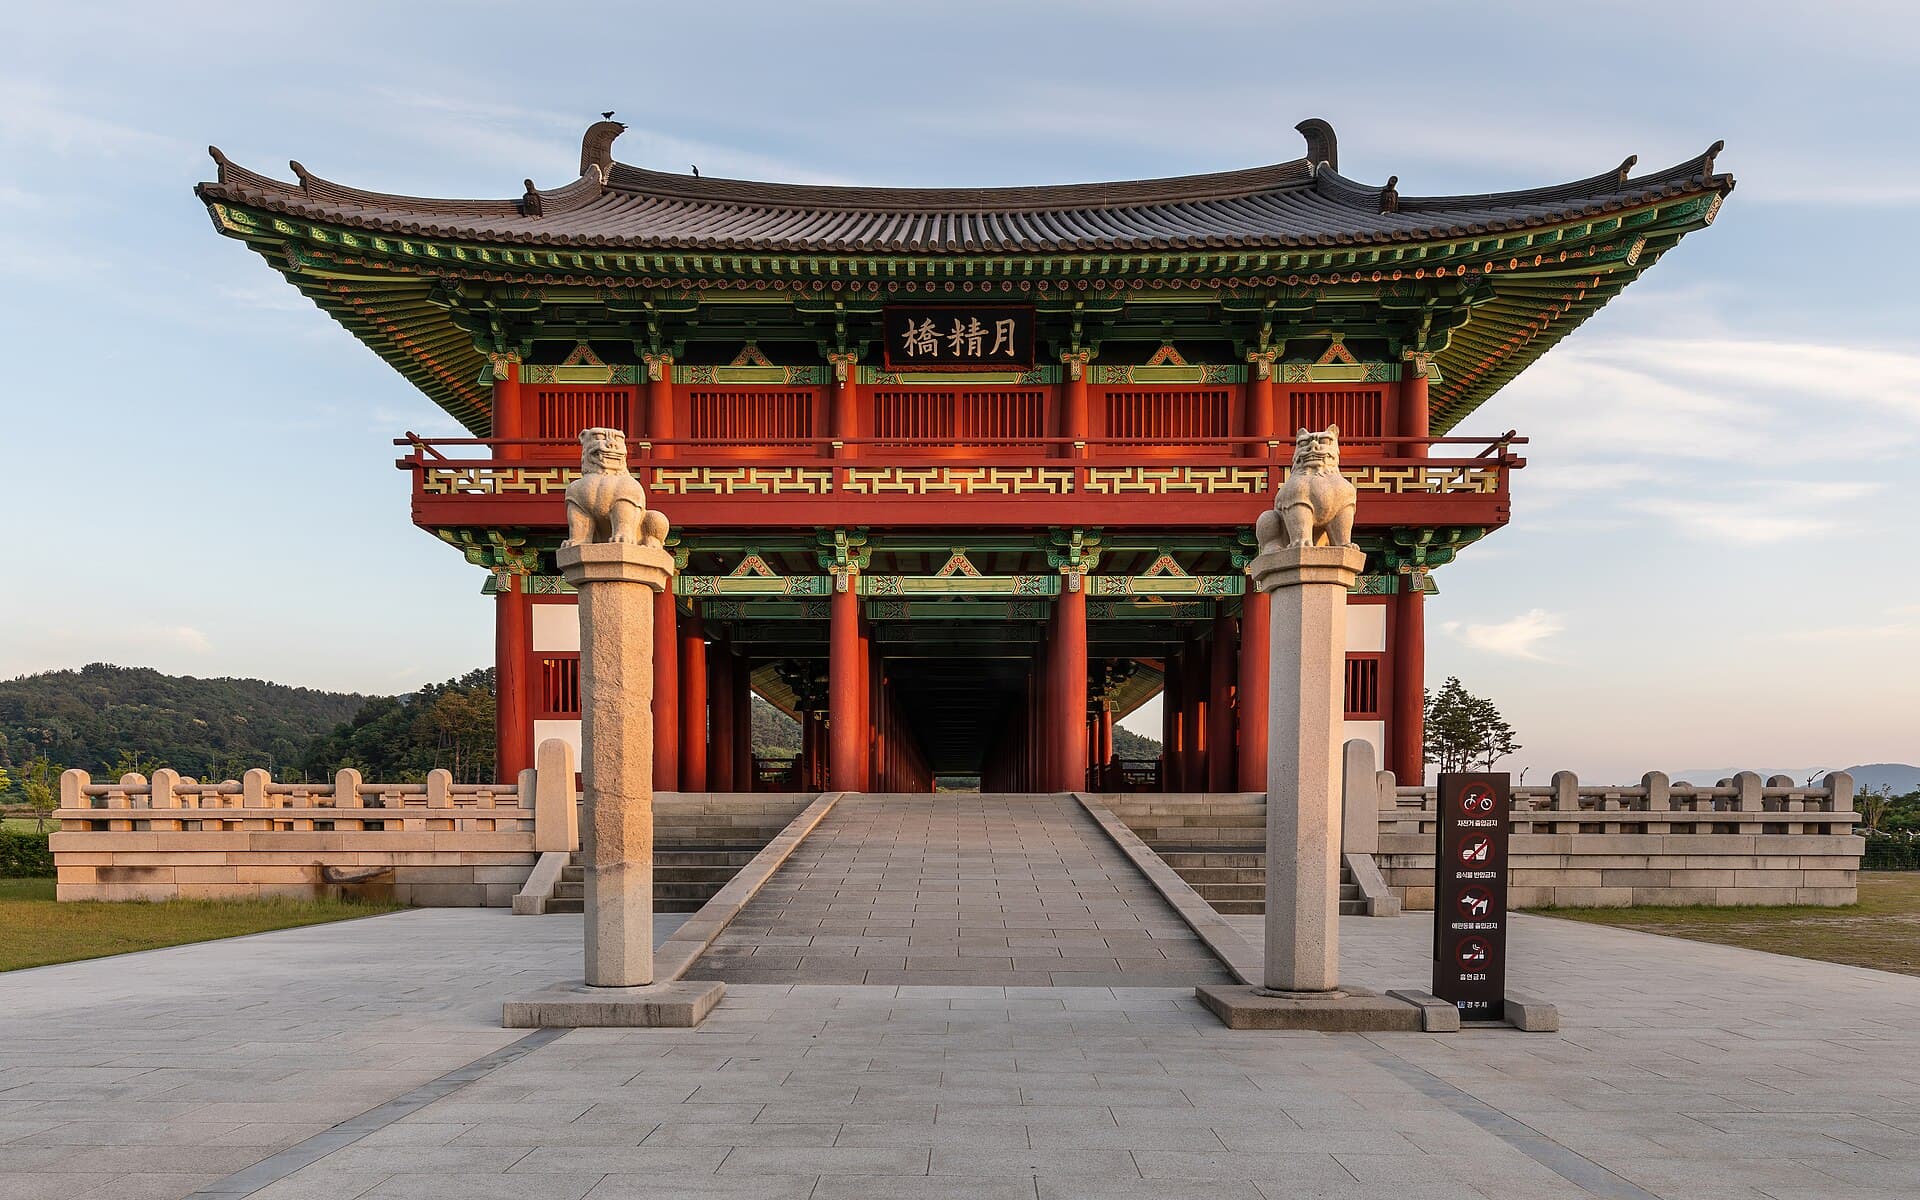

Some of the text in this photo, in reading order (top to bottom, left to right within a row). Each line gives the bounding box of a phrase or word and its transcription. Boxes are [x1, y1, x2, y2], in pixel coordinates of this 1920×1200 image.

[1457, 819, 1498, 827] 자전거 출입금지
[1456, 871, 1497, 879] 음식물 반입금지
[1451, 922, 1498, 930] 애완동물 출입금지
[1460, 973, 1486, 981] 흡연금지
[1466, 1001, 1488, 1009] 경주시
